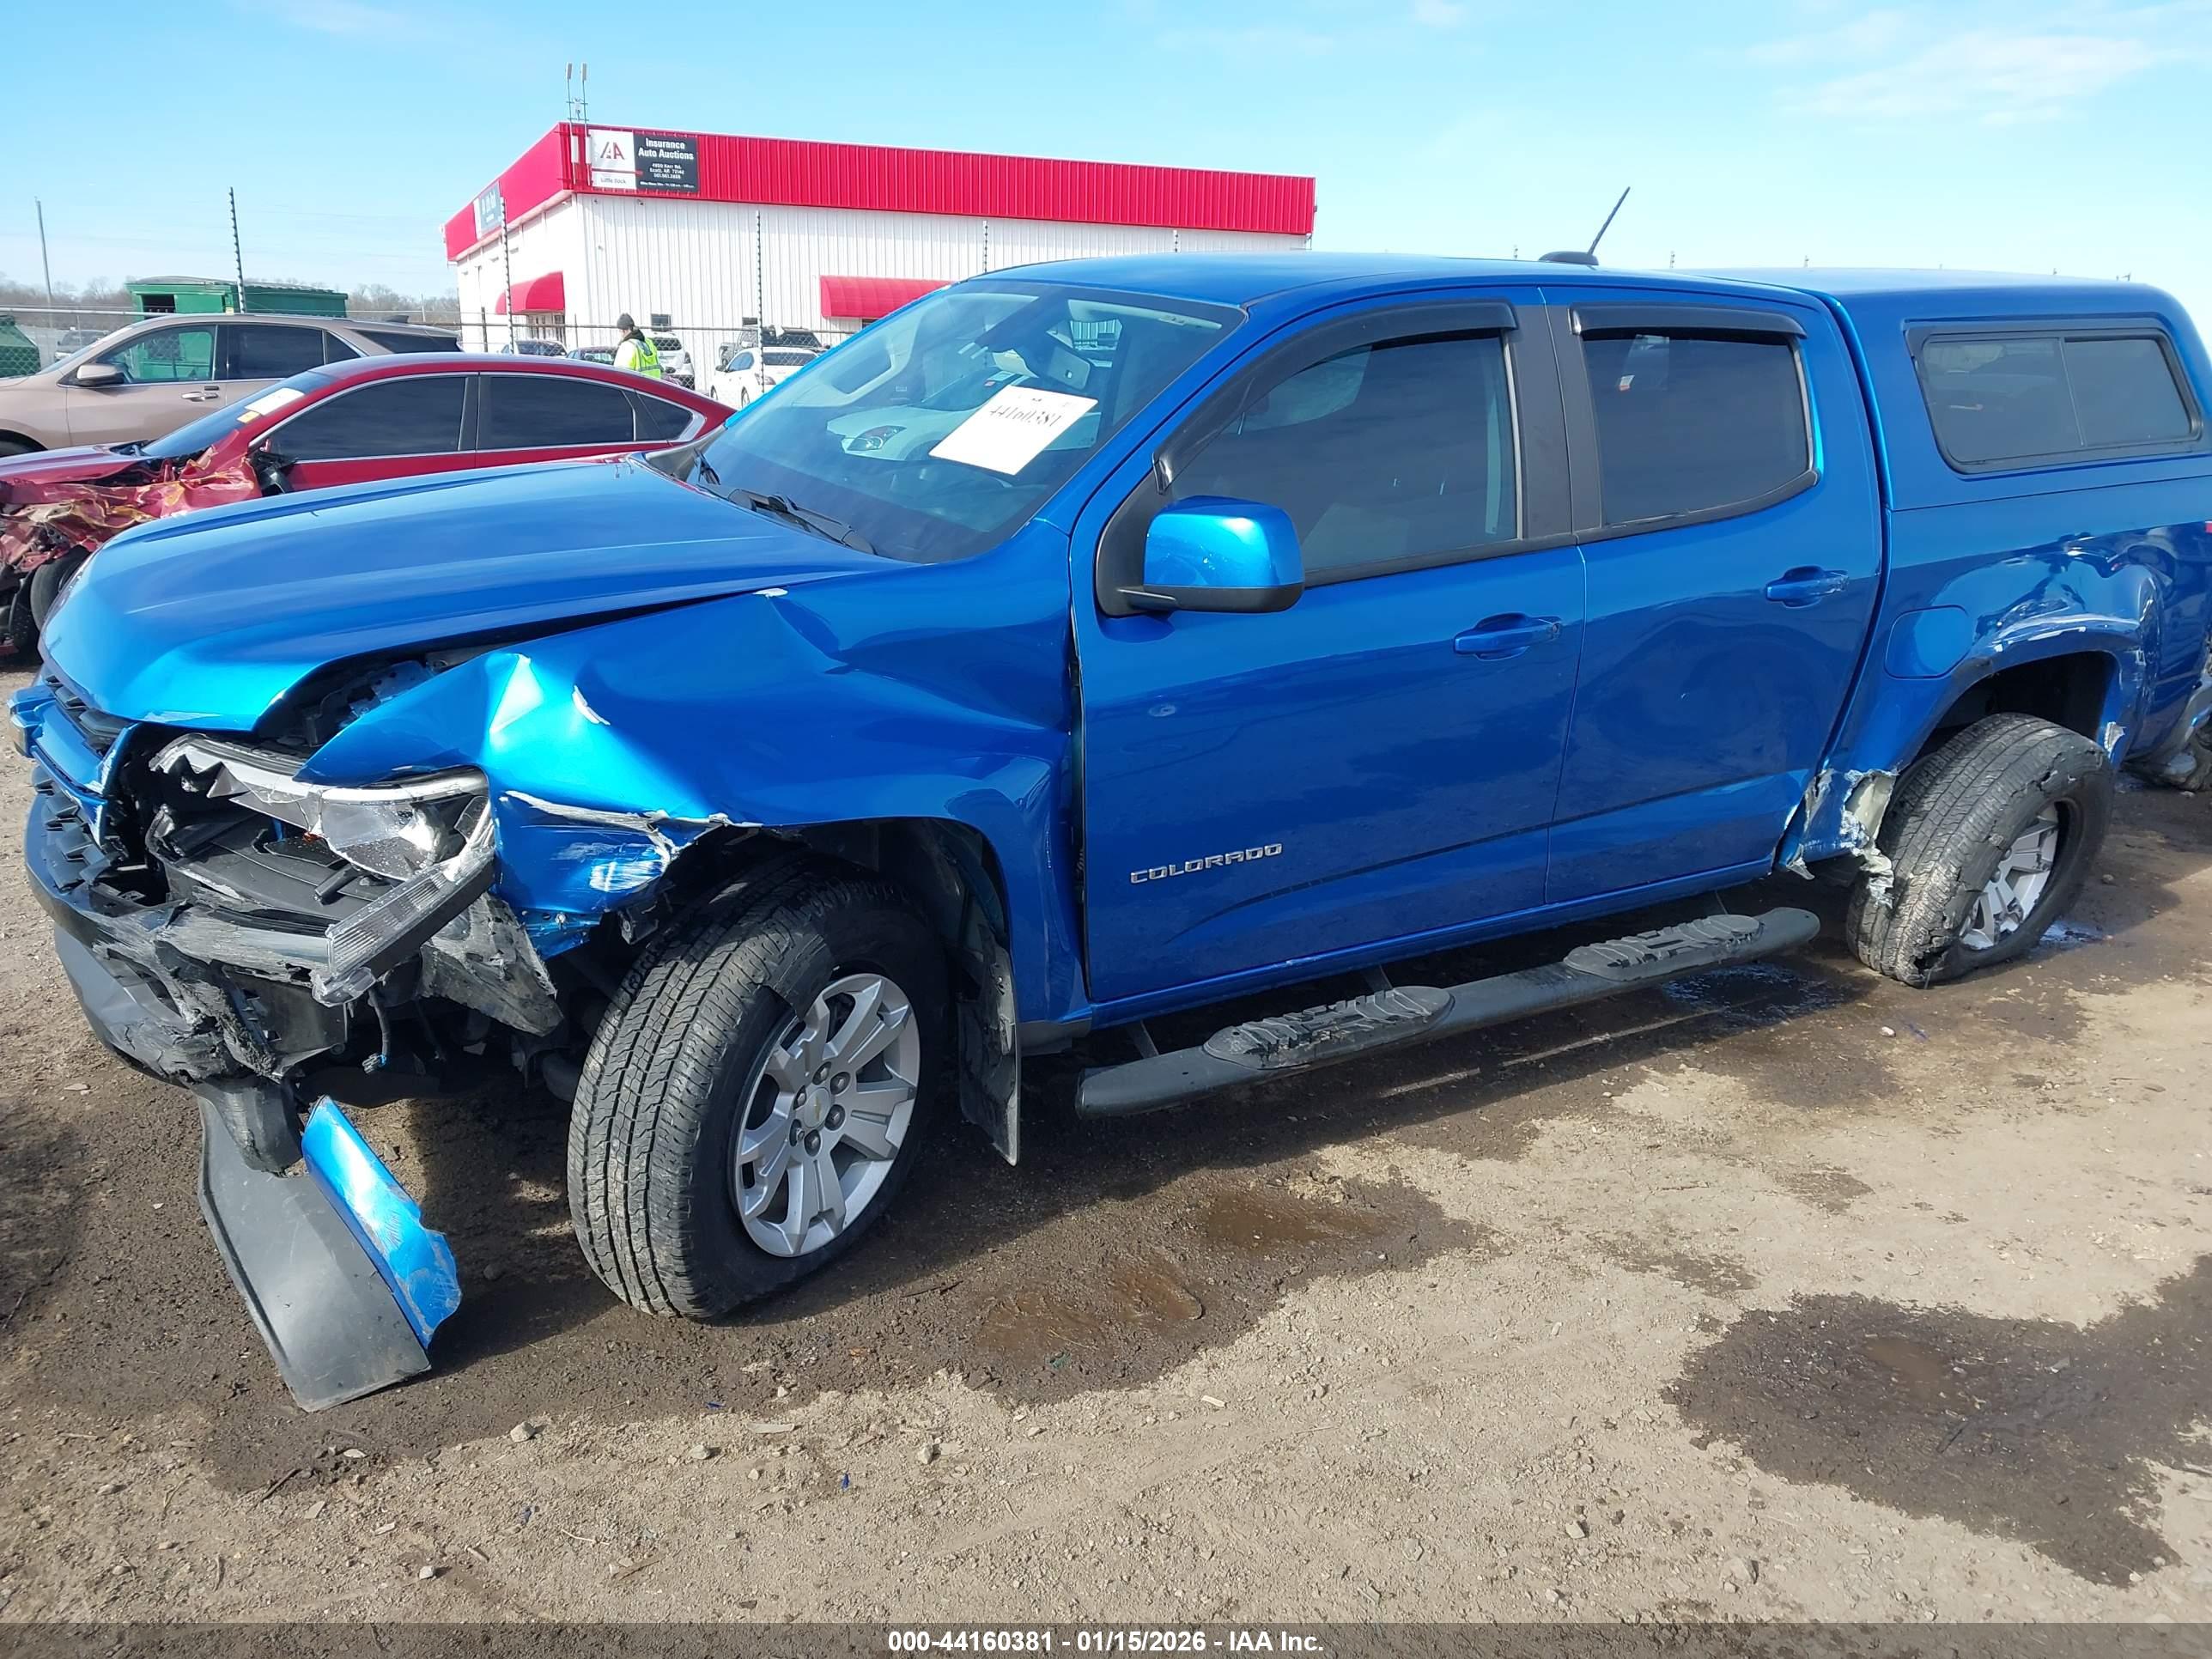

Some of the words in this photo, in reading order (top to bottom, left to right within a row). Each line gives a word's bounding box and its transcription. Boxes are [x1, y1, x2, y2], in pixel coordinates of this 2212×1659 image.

[645, 137, 685, 149] Insurance
[638, 148, 658, 157] Auto
[659, 150, 694, 160] Auctions
[1129, 843, 1283, 884] COLORADO
